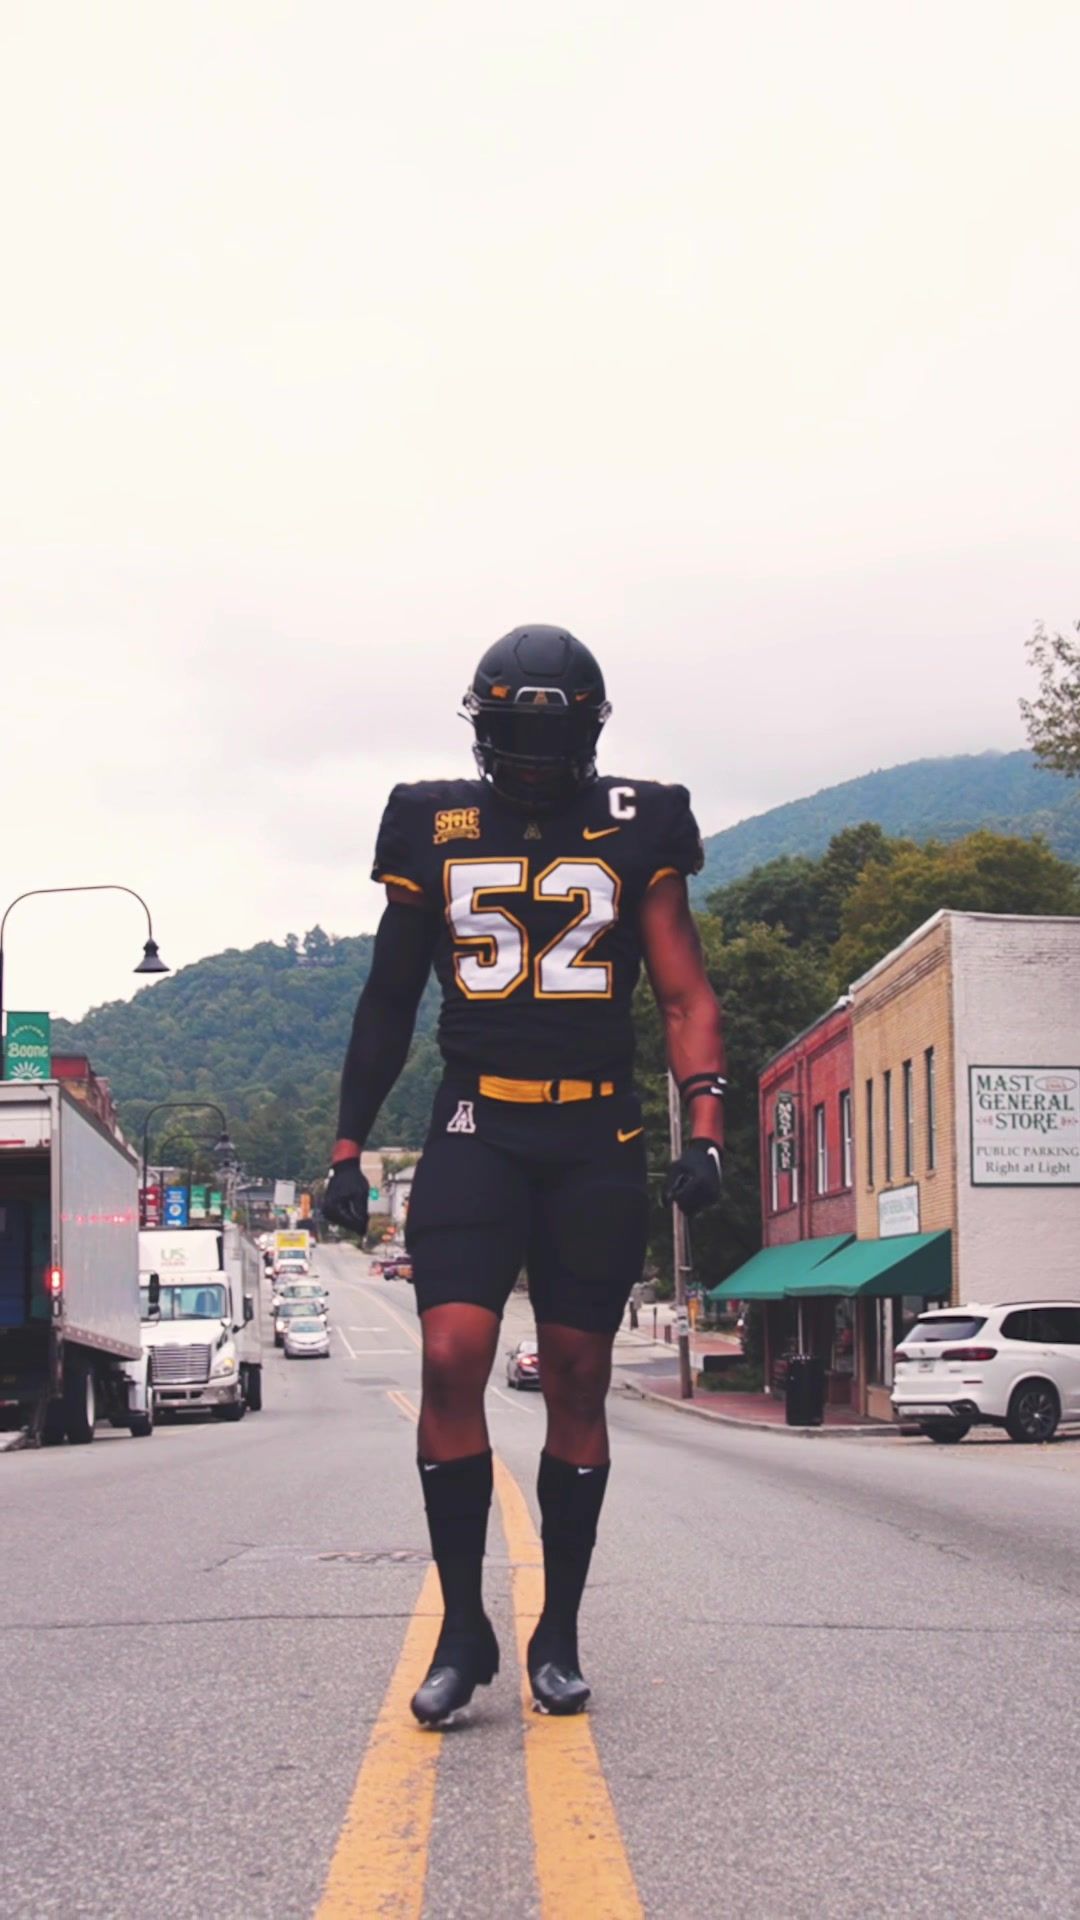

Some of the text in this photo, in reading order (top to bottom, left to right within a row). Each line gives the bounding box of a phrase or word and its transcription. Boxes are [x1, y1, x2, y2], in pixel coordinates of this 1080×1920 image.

[609, 786, 636, 820] C
[443, 857, 622, 999] 52
[977, 1074, 1034, 1095] MAST
[979, 1094, 1074, 1111] GENERAL
[995, 1112, 1057, 1134] STORE
[976, 1146, 1080, 1157] PUBLIC PARKING
[985, 1162, 1070, 1176] Right at Light
